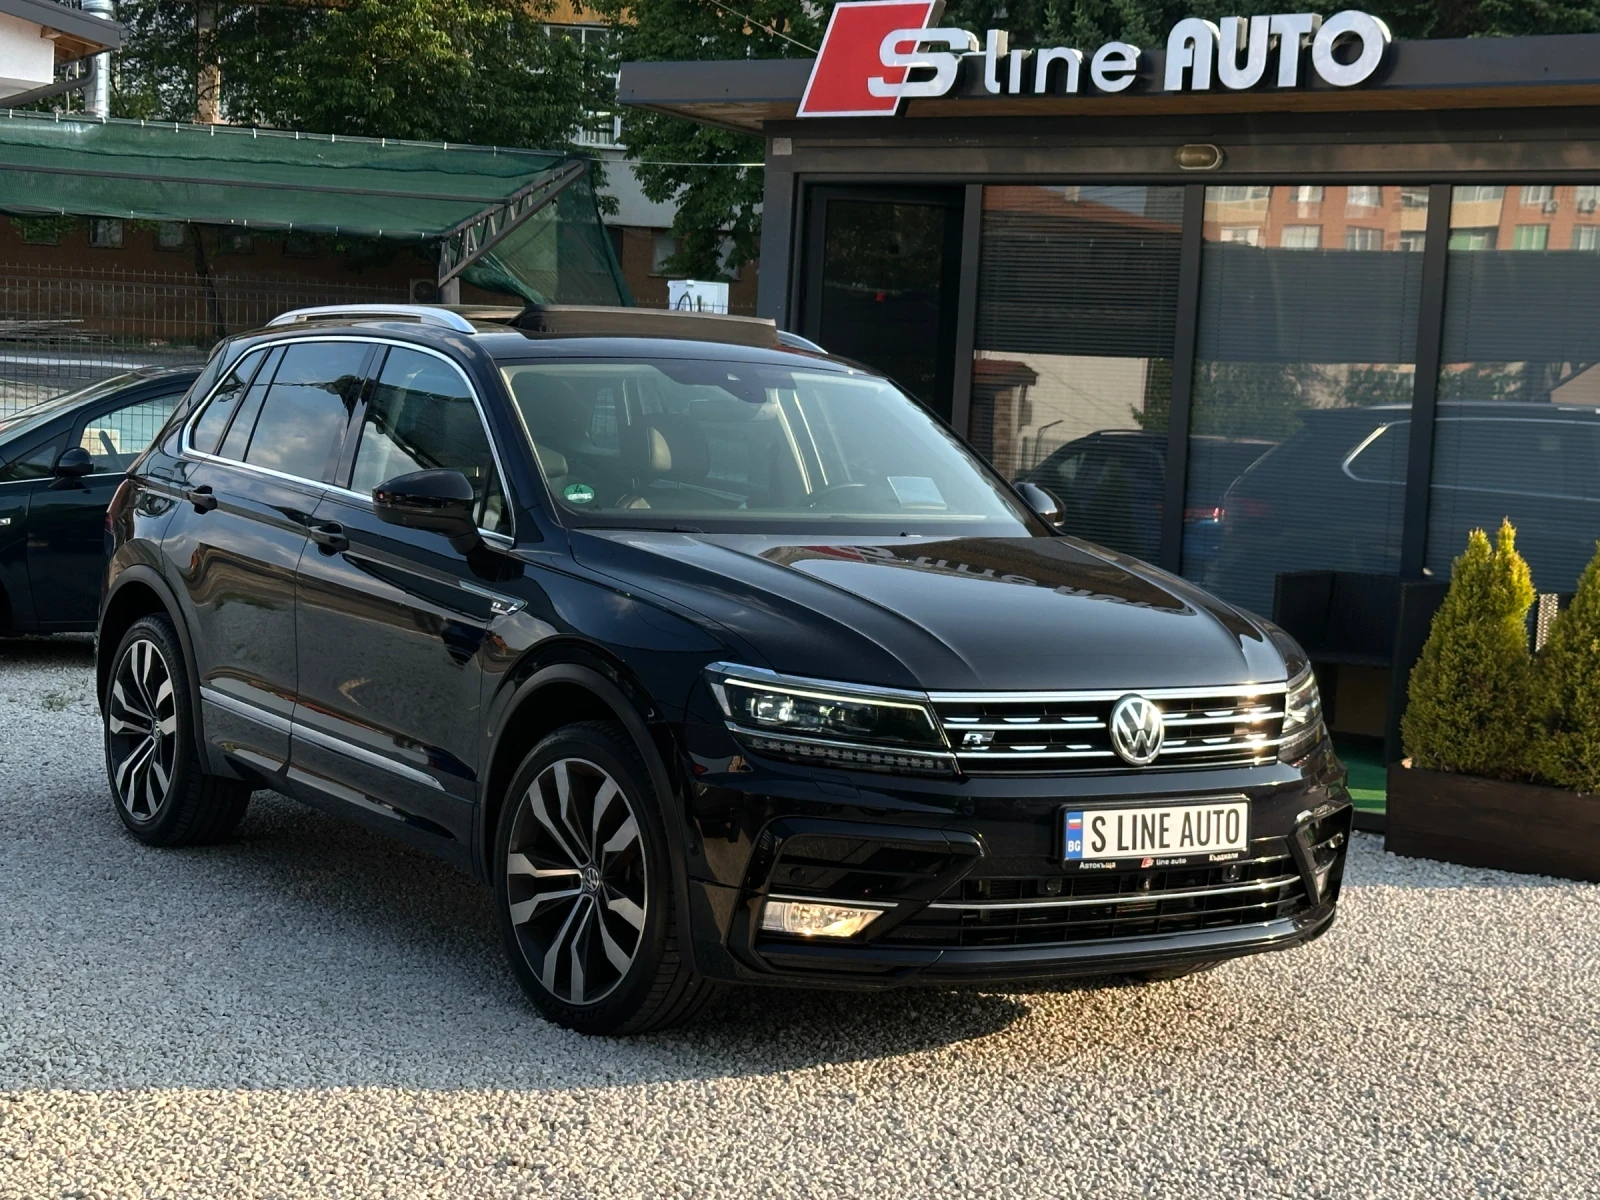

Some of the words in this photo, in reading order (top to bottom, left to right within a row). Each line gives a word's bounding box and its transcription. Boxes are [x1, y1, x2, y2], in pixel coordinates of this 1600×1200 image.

[985, 29, 1140, 94] line
[1165, 10, 1386, 91] AUTO
[1067, 840, 1081, 852] BG
[1091, 816, 1106, 852] S
[1117, 813, 1170, 850] LINE
[1179, 808, 1240, 847] AUTO
